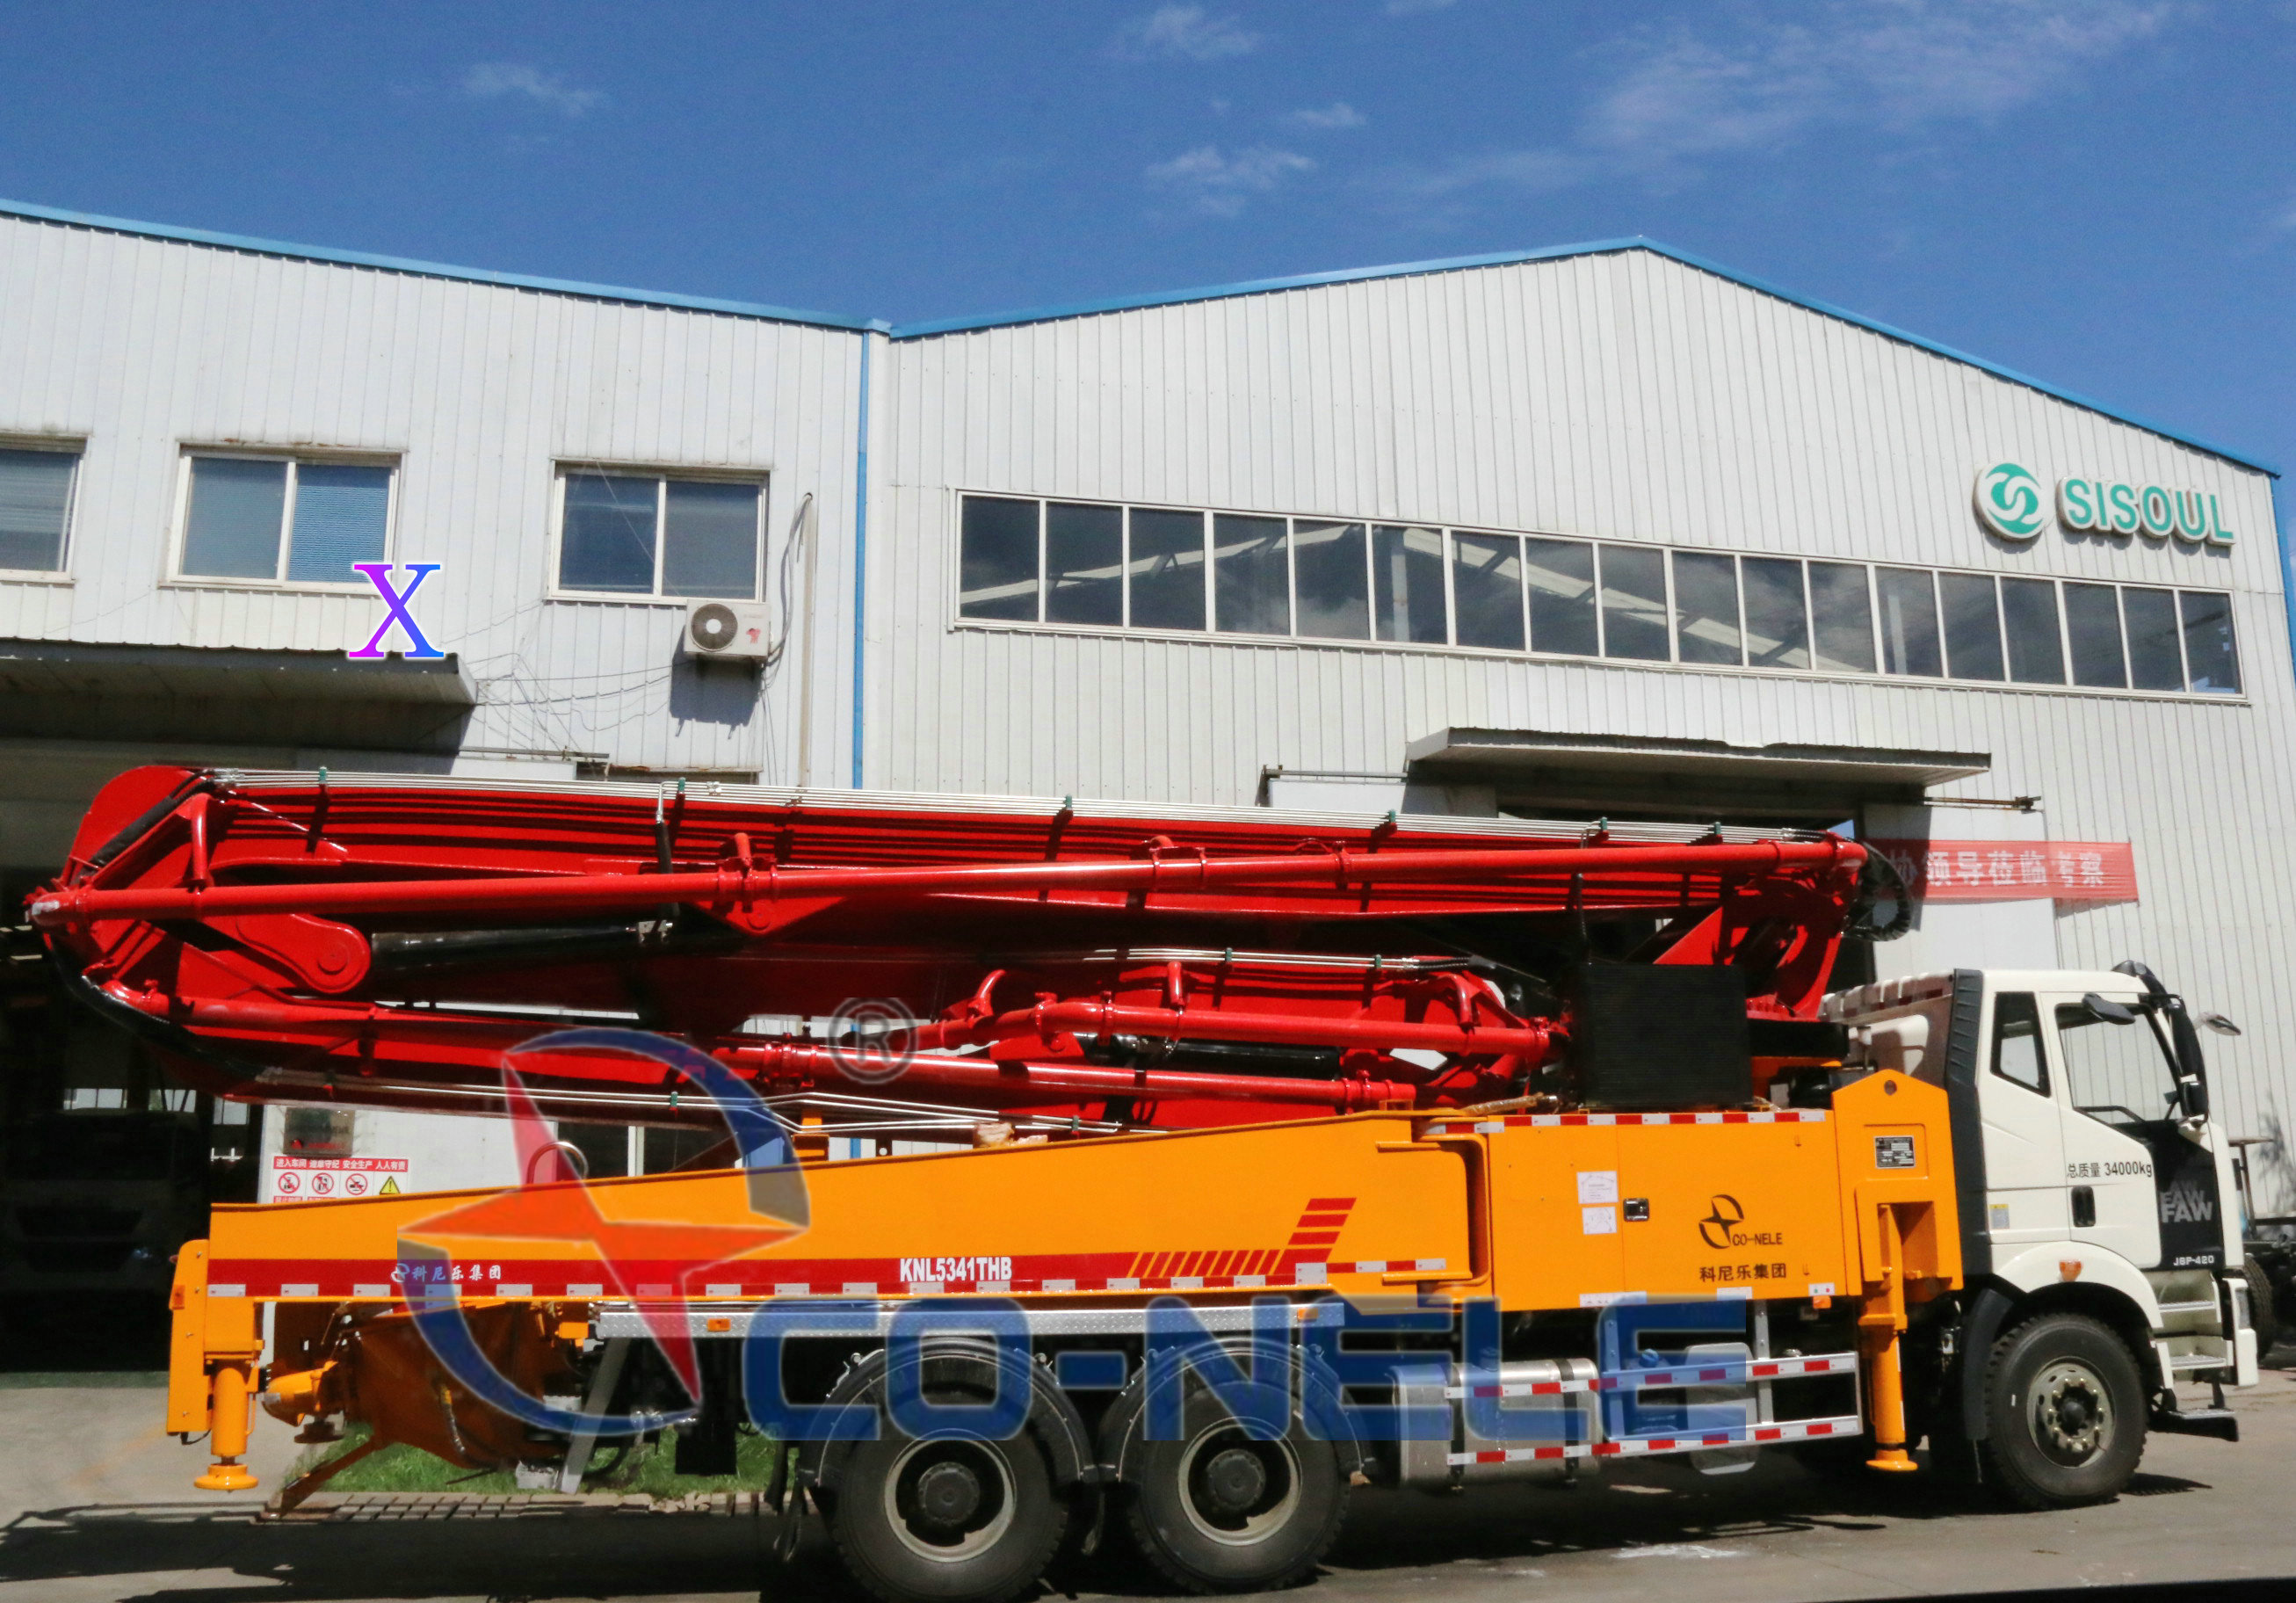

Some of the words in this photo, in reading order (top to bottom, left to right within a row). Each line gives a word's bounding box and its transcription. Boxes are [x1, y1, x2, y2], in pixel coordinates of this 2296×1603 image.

[2061, 477, 2235, 541] SISOUL
[342, 1160, 373, 1170] 安全生产
[375, 1161, 406, 1171] 人人有责
[2067, 1163, 2101, 1178] 总质量
[2104, 1161, 2152, 1178] 34000kg
[2161, 1201, 2213, 1222] FAW
[1732, 1232, 1783, 1246] CO-NELE
[412, 1264, 502, 1282] 科尼乐集团
[900, 1256, 1012, 1282] KNL5341THB
[1699, 1263, 1786, 1282] 科尼乐集团
